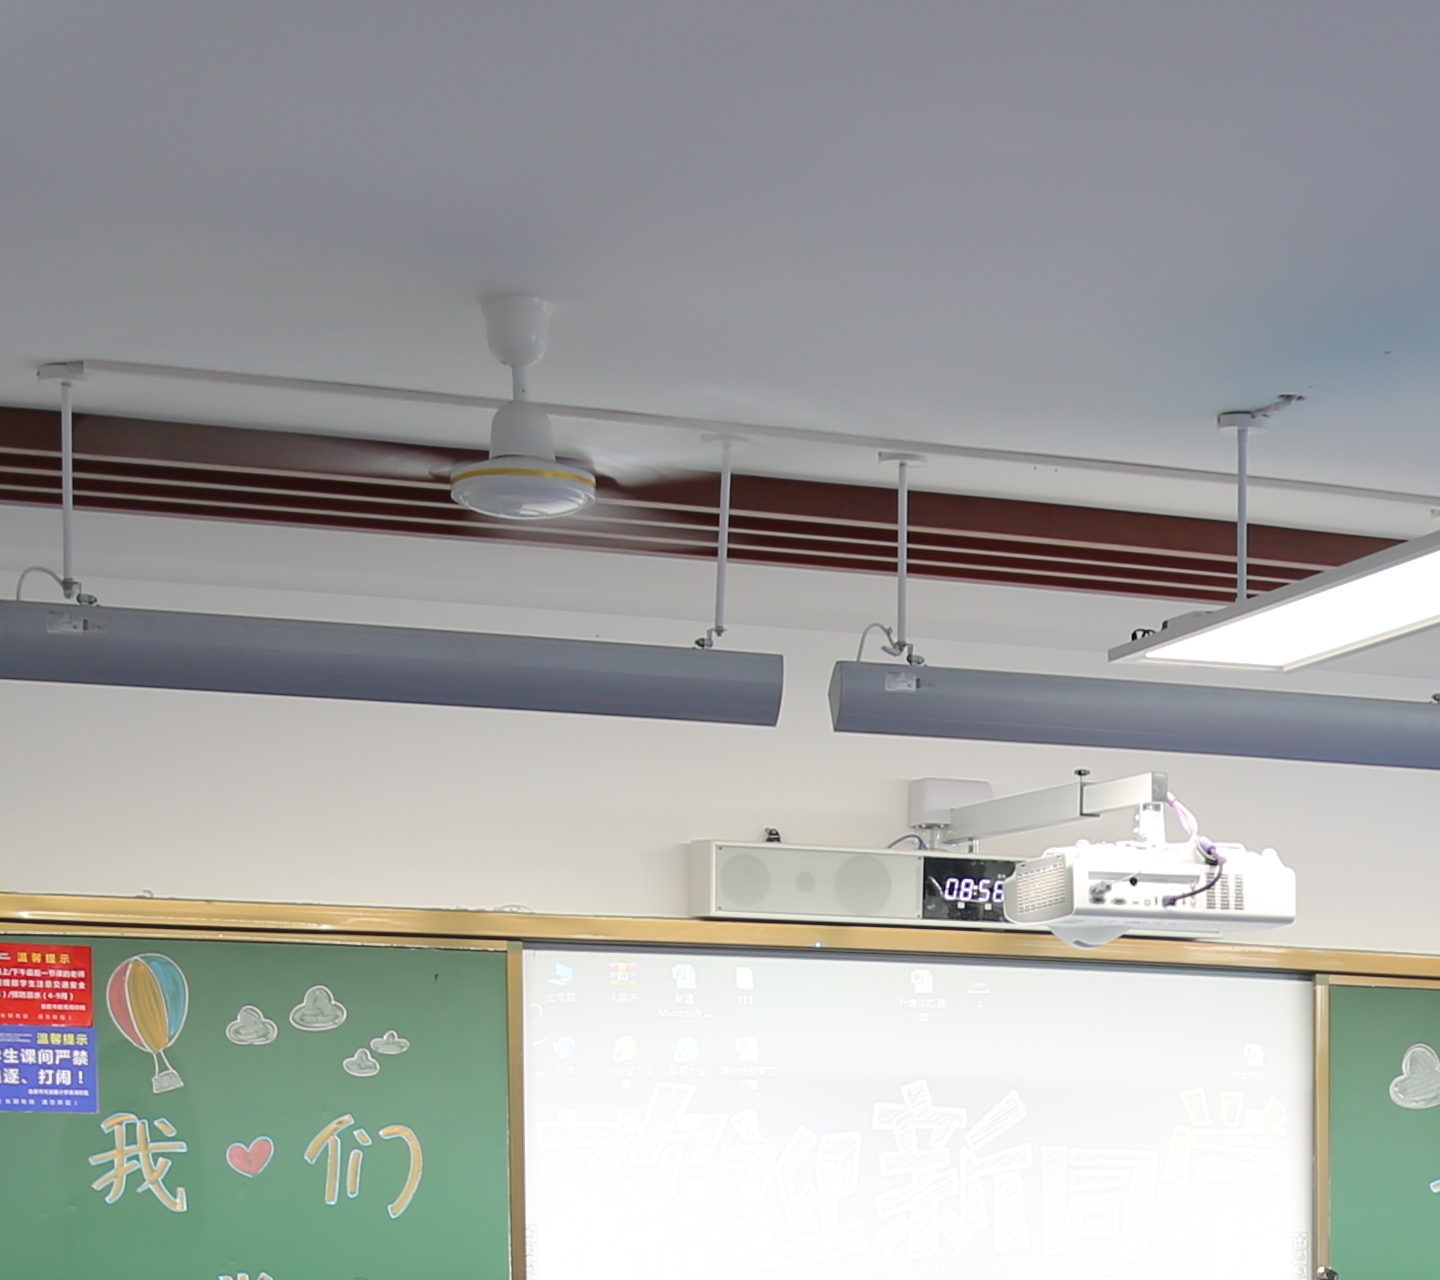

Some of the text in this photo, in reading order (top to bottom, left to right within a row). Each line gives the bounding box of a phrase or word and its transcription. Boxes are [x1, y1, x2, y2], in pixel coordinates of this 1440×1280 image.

[17, 952, 71, 964] 温馨提示
[658, 1007, 703, 1019] Microsoft
[36, 1032, 89, 1046] 温馨提示
[89, 1113, 423, 1219] 我们
